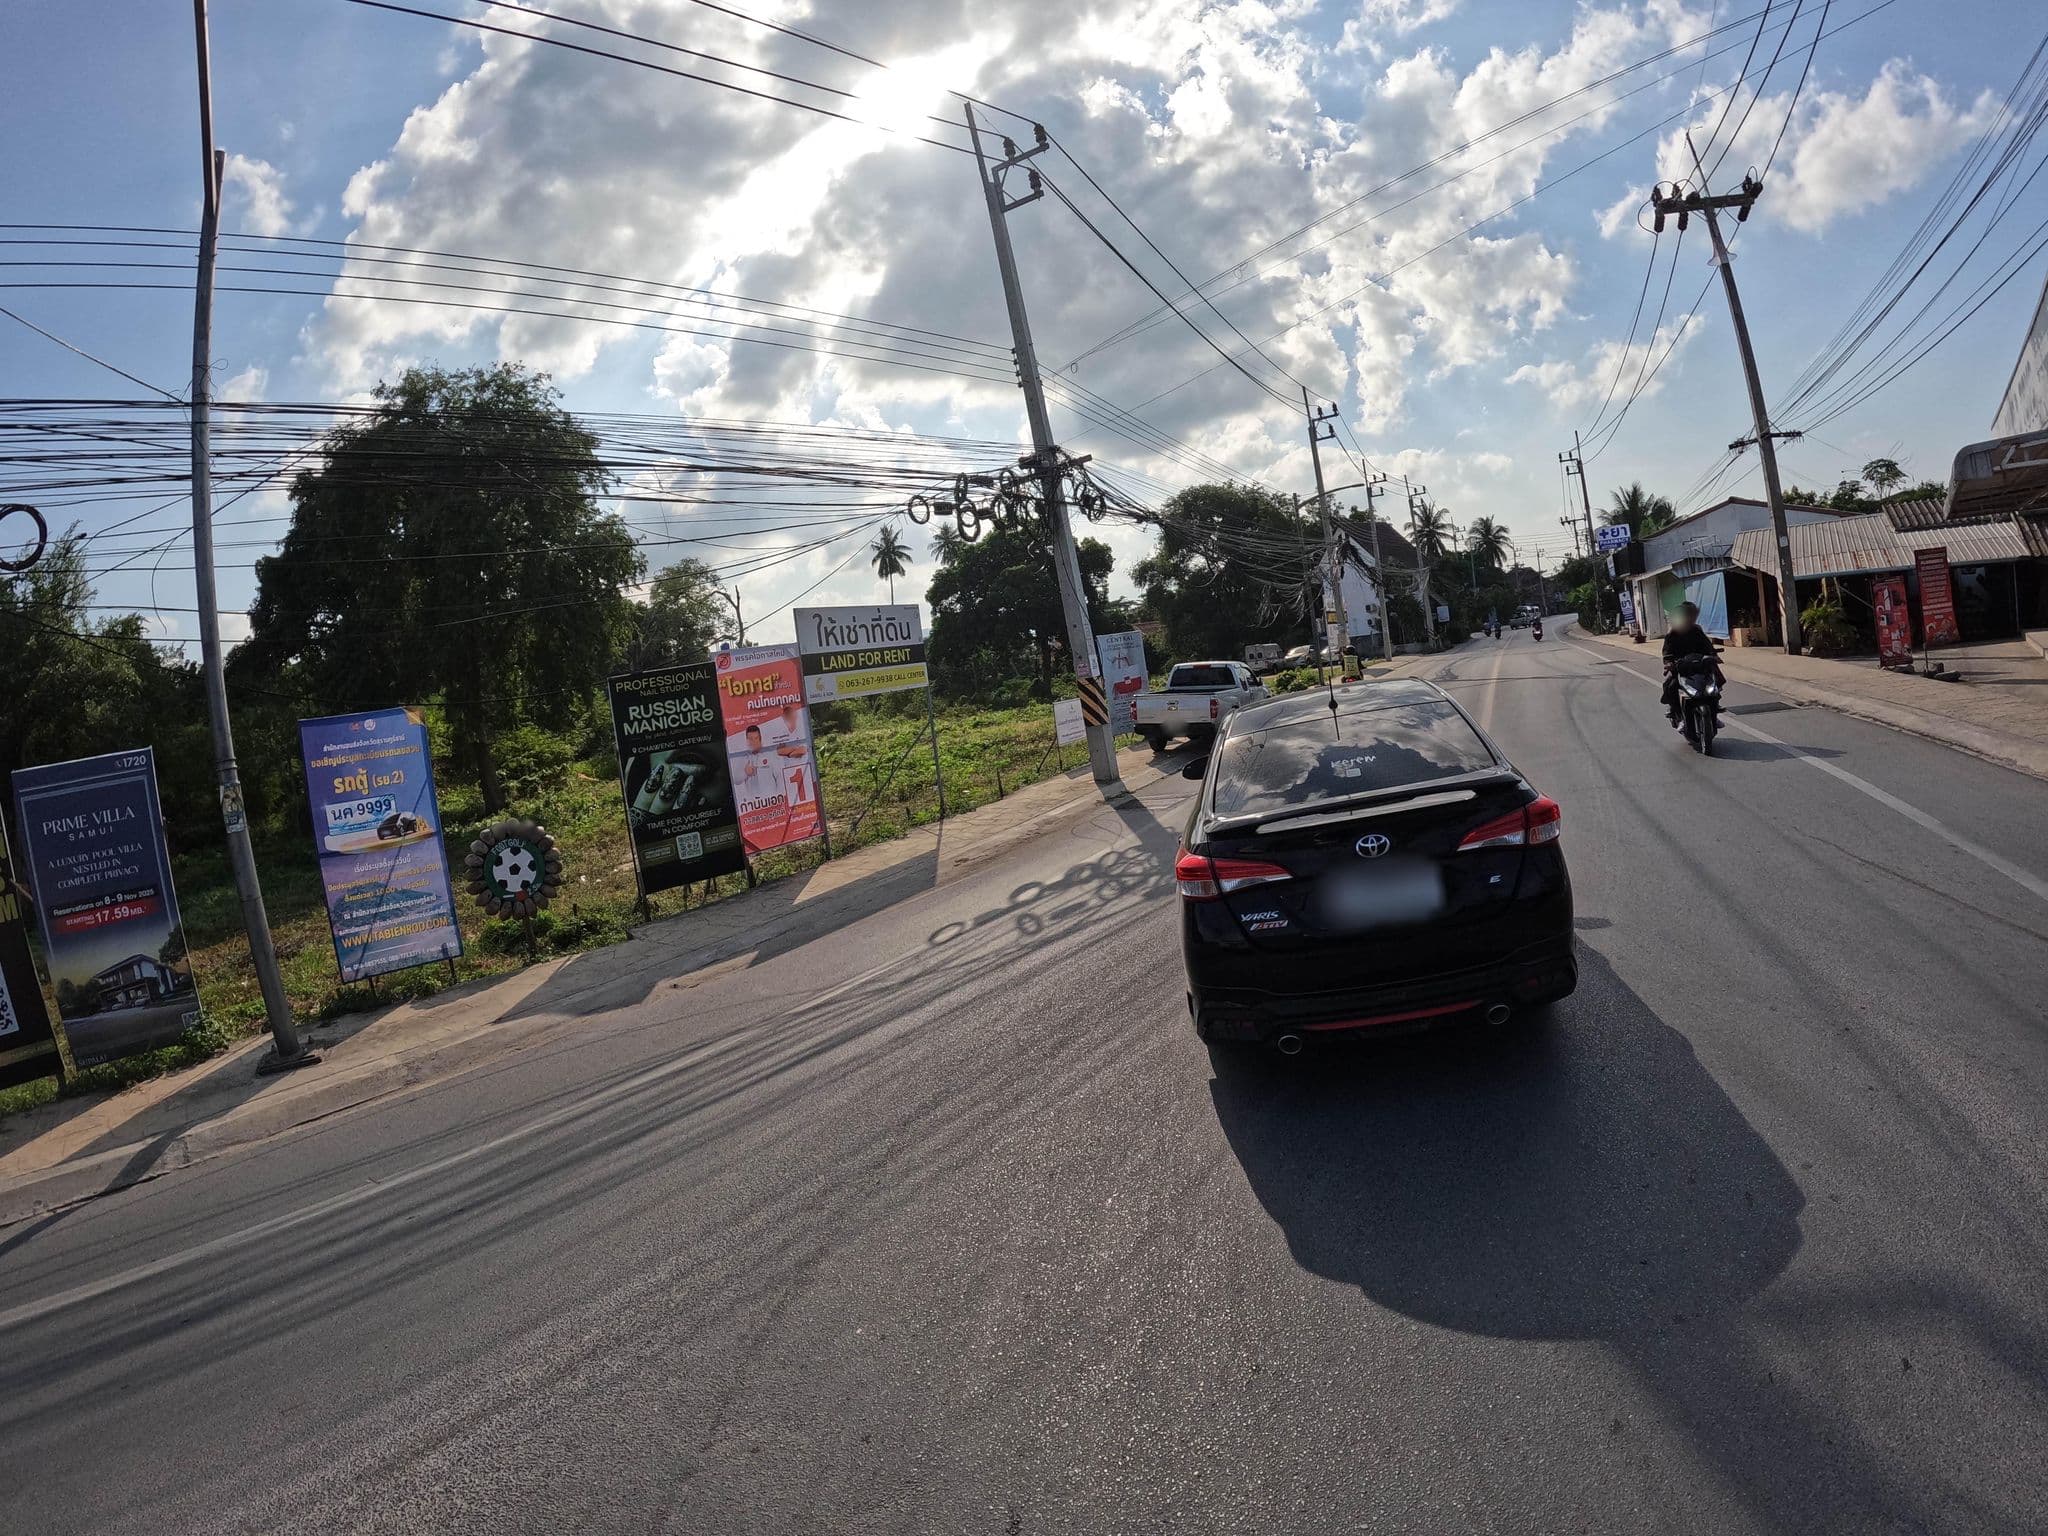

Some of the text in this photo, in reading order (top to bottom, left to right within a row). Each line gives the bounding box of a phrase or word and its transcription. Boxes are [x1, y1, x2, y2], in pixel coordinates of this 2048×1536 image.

[1610, 526, 1628, 537] ยา
[812, 608, 912, 647] ให้เช่าที่ดิน
[821, 648, 911, 671] LAND FOR RENT
[615, 669, 711, 693] PROFESSIONAL
[845, 670, 926, 688] 063-267-9938 CALL CENTER
[639, 683, 690, 697] NAIL STUDIO
[747, 693, 801, 710] คนไทยทุกคน
[638, 734, 713, 753] CHAWENG GATEWAY
[123, 754, 147, 768] 1720
[334, 768, 369, 795] รถตู้
[790, 768, 806, 801] 1
[331, 799, 393, 821] นค 9999
[741, 794, 785, 813] กำนันเอก
[42, 806, 136, 835] PRIME VILLA
[646, 820, 666, 831] TIME
[666, 816, 682, 826] FOR
[662, 819, 711, 835] IN COMFORT
[69, 826, 113, 841] SAMUI
[49, 842, 143, 870] A LUXURY POOL VILLA
[73, 858, 121, 875] NESTLED IN
[57, 864, 141, 889] COMPLETE PRIVACY
[53, 902, 94, 916] Reservations
[95, 900, 104, 908] on
[124, 894, 137, 902] Nov
[65, 915, 95, 926] STARTING
[95, 906, 130, 924] 17.59
[1241, 911, 1279, 922] YARIS
